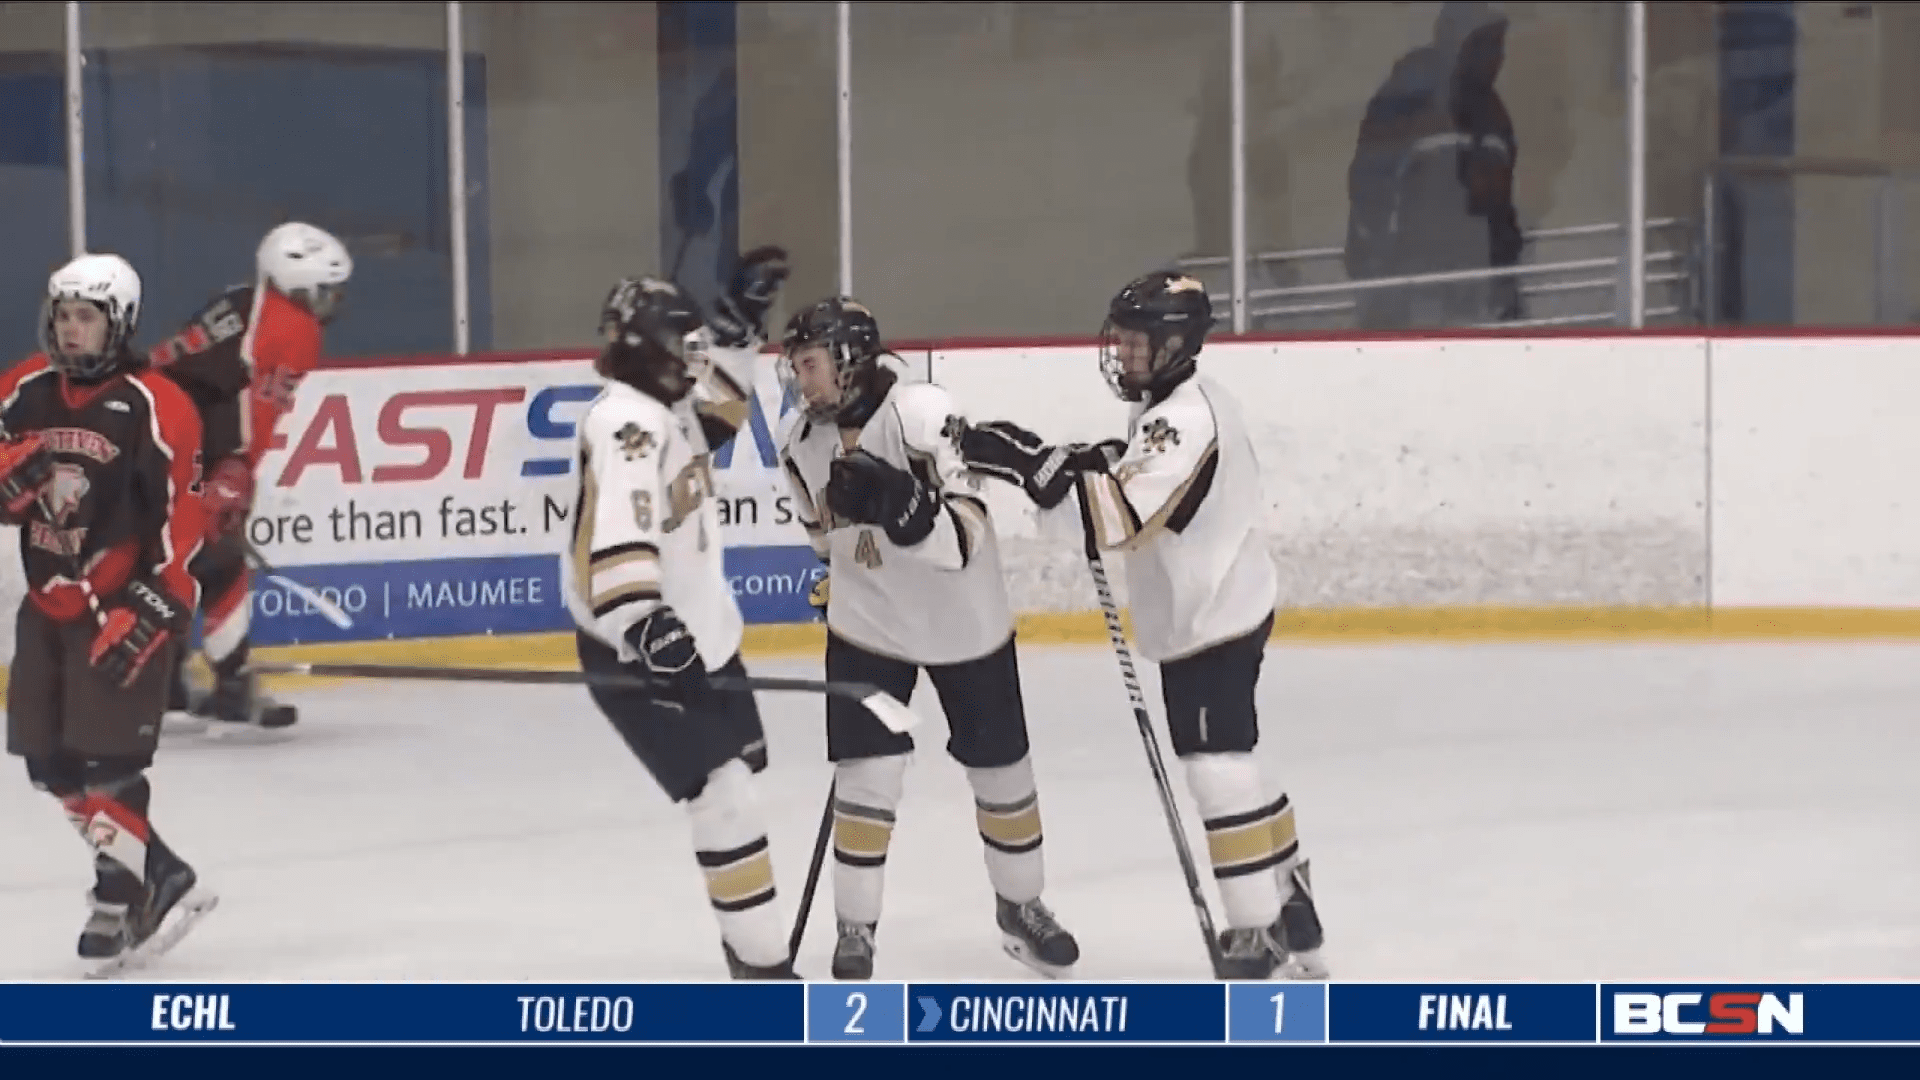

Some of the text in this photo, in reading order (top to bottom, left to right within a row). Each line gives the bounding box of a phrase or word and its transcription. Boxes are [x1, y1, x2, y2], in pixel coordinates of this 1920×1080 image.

[251, 512, 314, 545] ore
[328, 499, 422, 542] than
[438, 496, 528, 538] fast.
[854, 529, 884, 570] 4
[406, 577, 544, 608] MAUMEE
